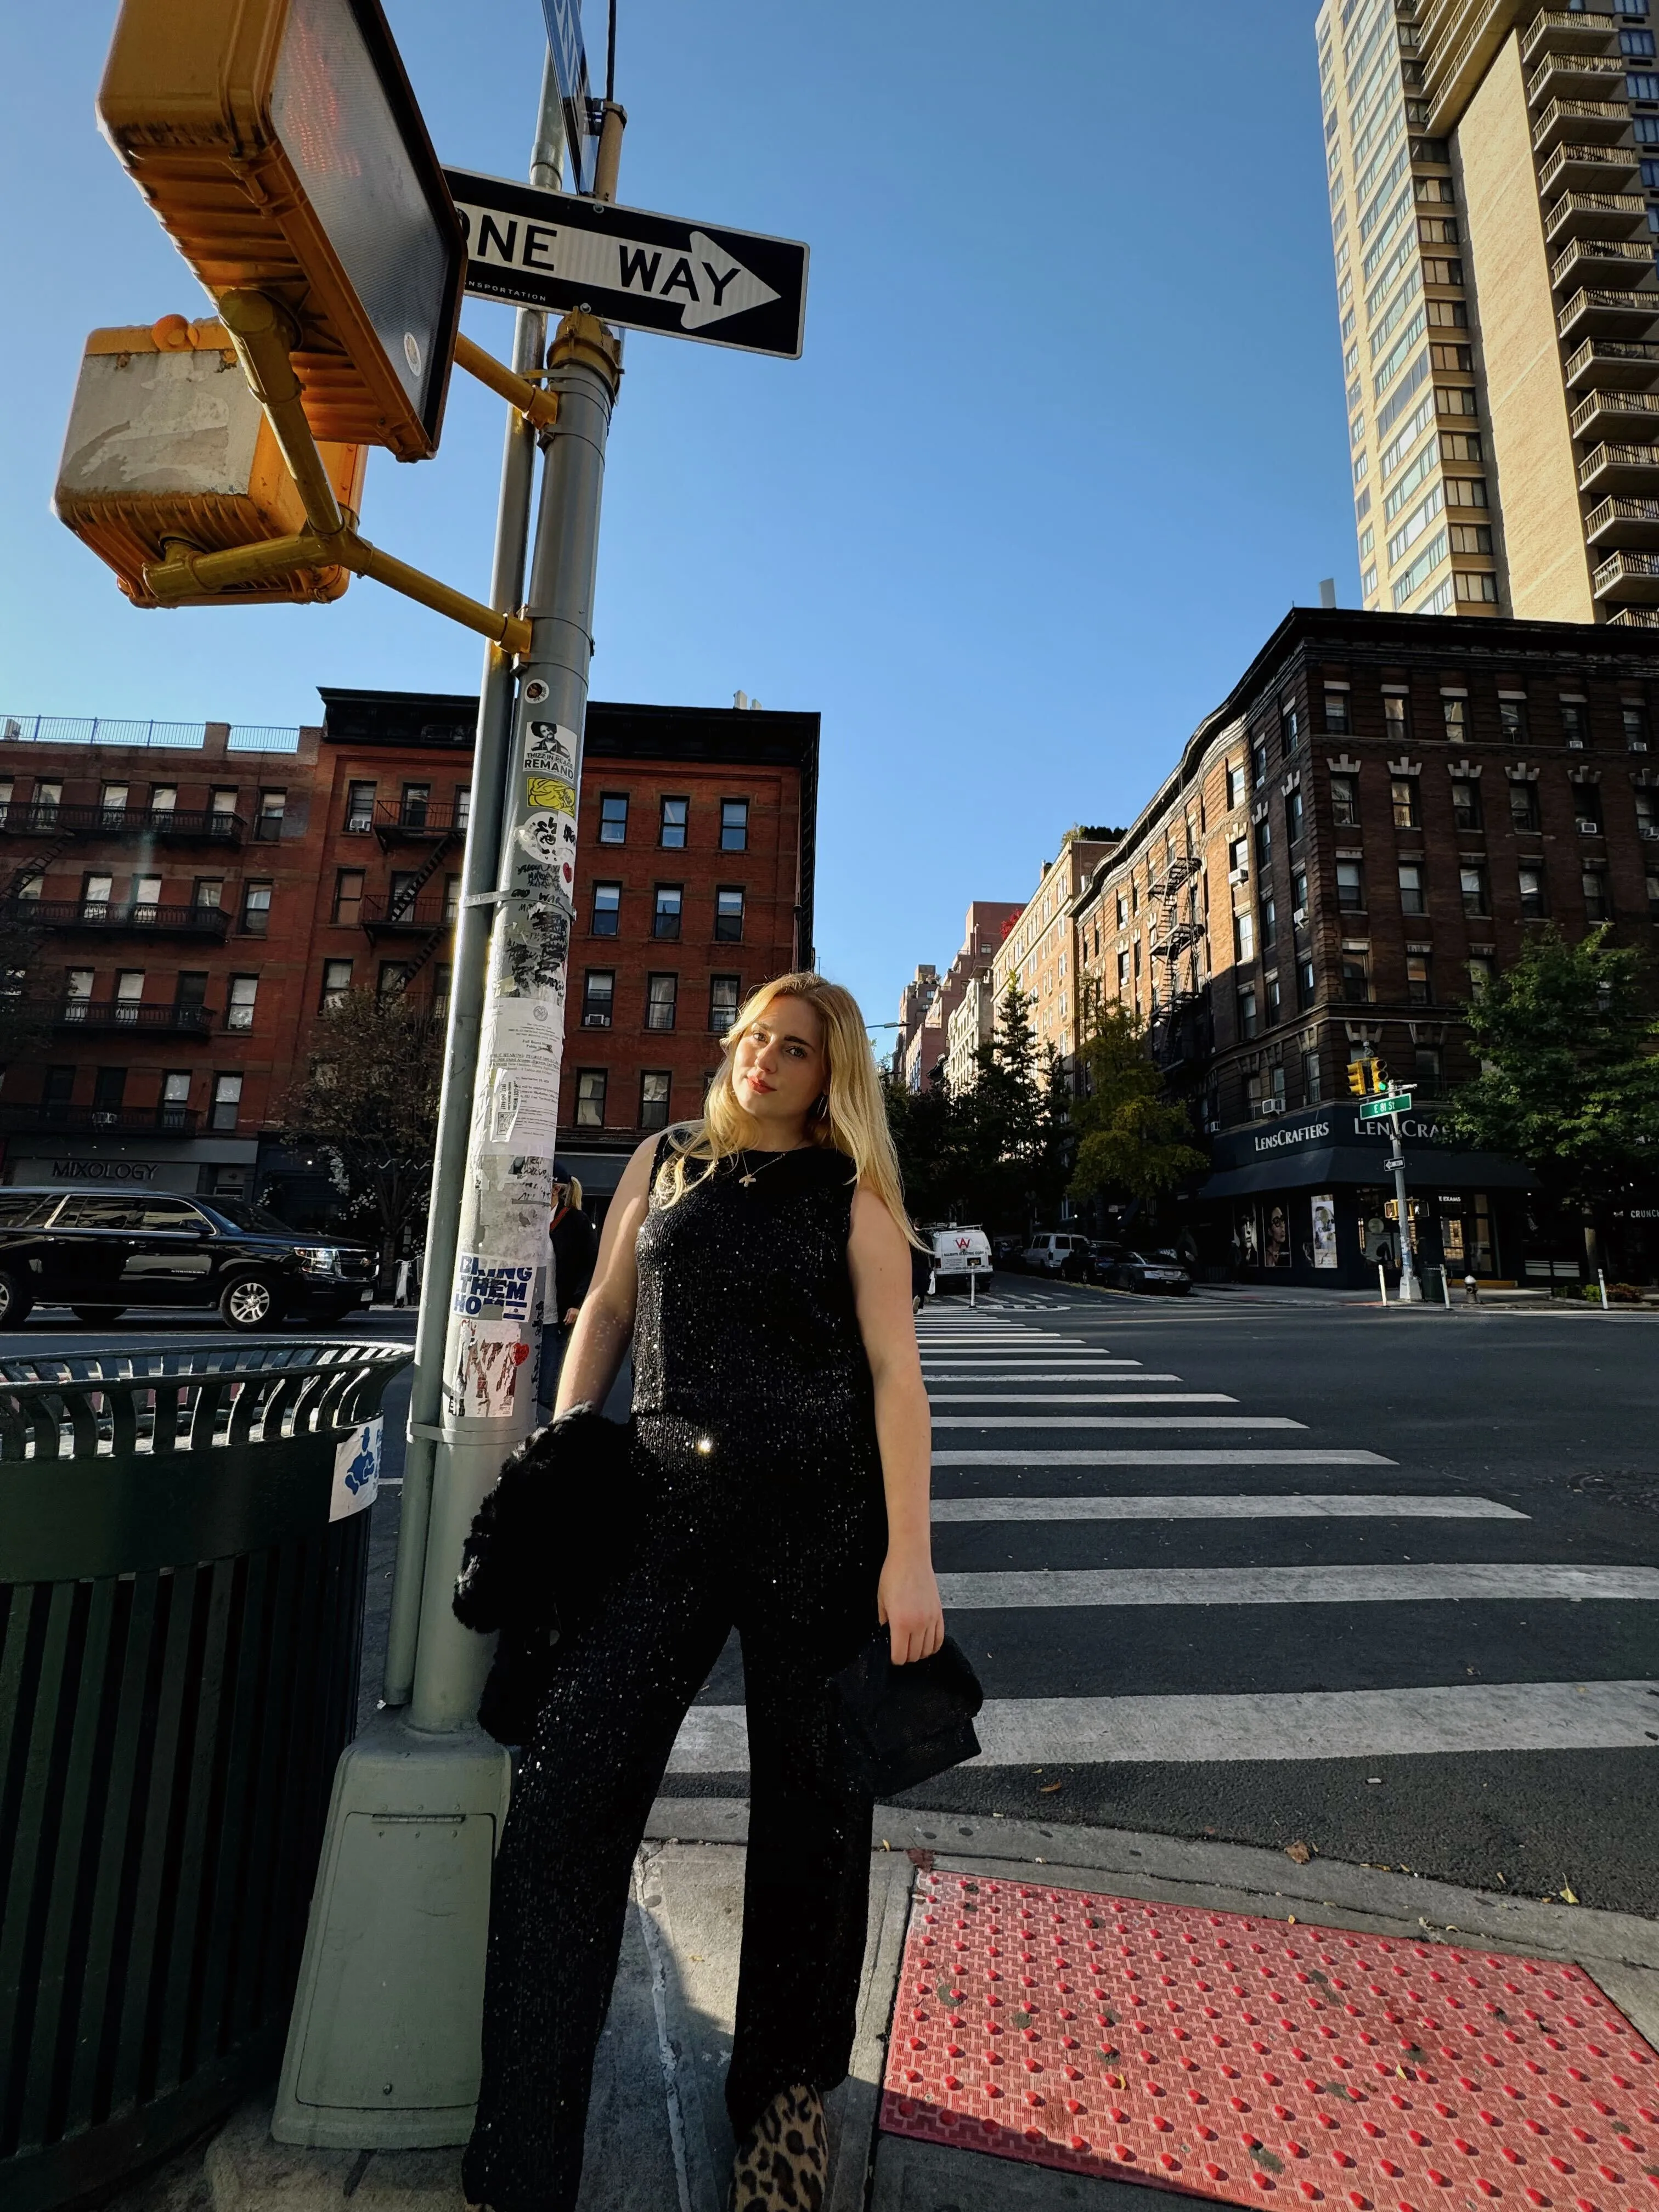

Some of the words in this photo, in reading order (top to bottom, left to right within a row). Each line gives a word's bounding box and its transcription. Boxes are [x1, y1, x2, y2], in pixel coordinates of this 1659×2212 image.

[619, 244, 741, 306] WAY
[465, 280, 546, 301] NSPORTATION
[524, 759, 574, 780] REMAND
[555, 757, 574, 769] PEACE
[1374, 1104, 1378, 1114] E
[1380, 1103, 1386, 1112] 81
[1388, 1101, 1395, 1110] St
[1354, 1118, 1451, 1138] LENCRA
[52, 1161, 159, 1180] MIXOLOGY
[460, 1255, 533, 1282] BRING
[460, 1274, 528, 1301] THEM
